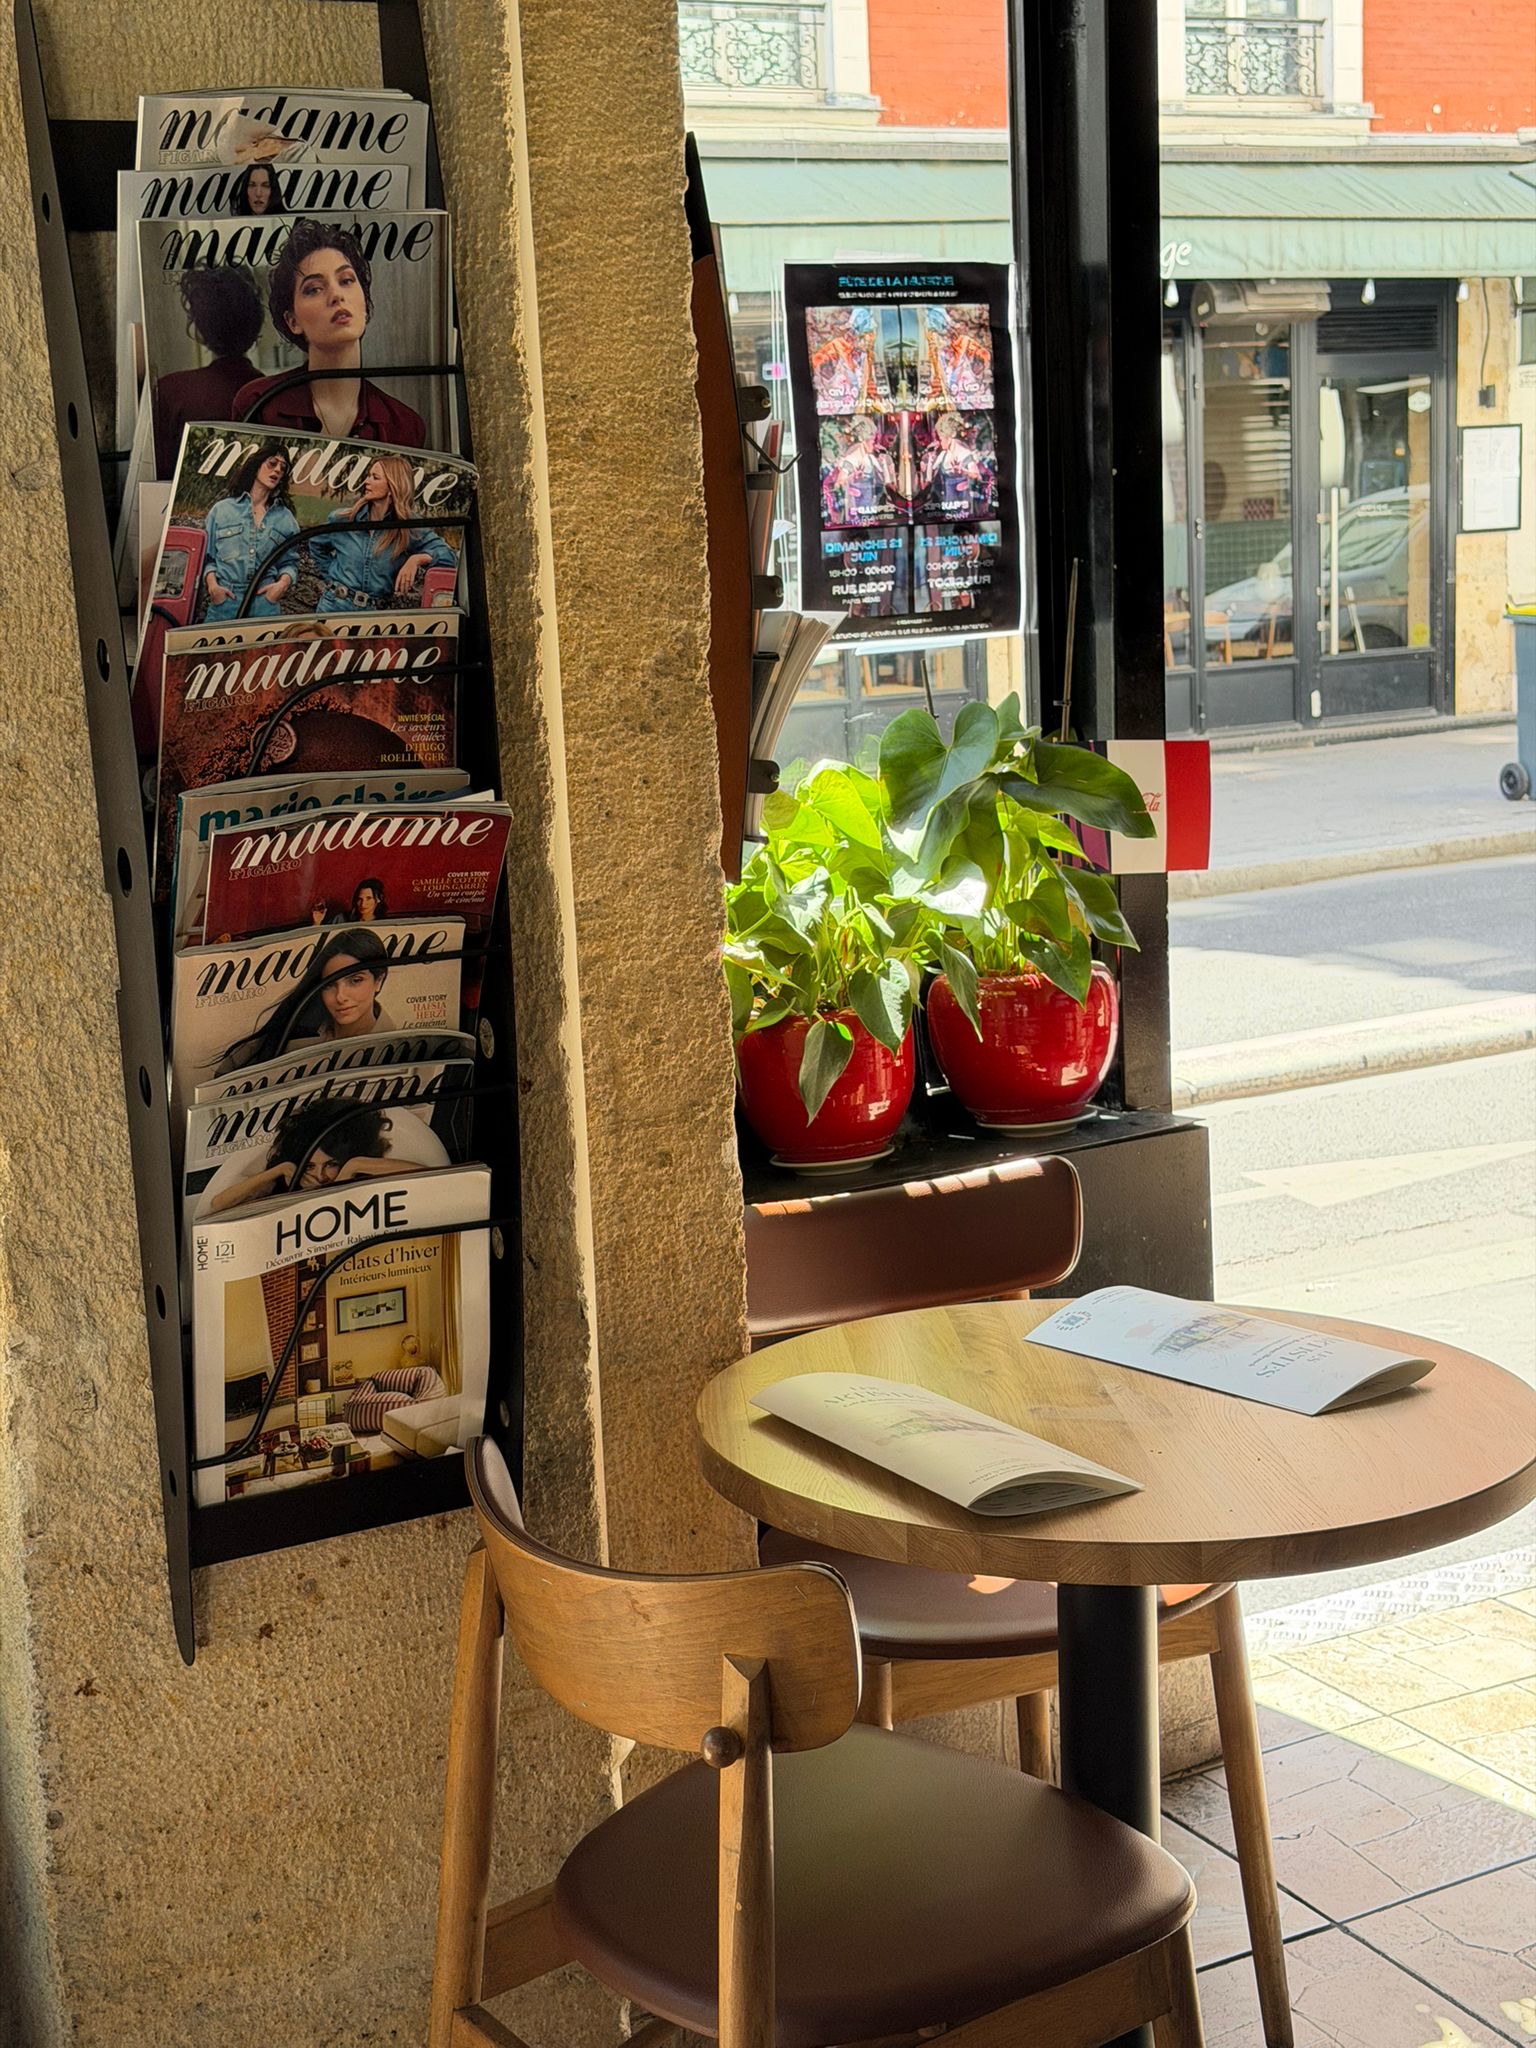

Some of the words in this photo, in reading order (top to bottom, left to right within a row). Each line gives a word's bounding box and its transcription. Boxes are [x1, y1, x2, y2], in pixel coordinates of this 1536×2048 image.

[184, 640, 441, 700] madame
[184, 691, 257, 713] FIGARO
[390, 722, 406, 732] Les
[408, 722, 446, 732] saveurs
[411, 732, 446, 742] étoilées
[380, 753, 445, 763] ROELLINGER
[406, 742, 446, 752] D'HUGO
[231, 811, 494, 870] madame
[229, 859, 301, 881] FIGARO
[412, 877, 451, 886] CAMILLE
[453, 876, 488, 884] COTTIN
[423, 884, 450, 892] LOUIS
[195, 985, 267, 1009] FIGARO
[406, 995, 427, 1004] COVER
[428, 994, 447, 1002] STORY
[416, 1010, 446, 1019] HERZI
[206, 1132, 274, 1158] FIGARO
[276, 1190, 408, 1255] HOME
[216, 1243, 235, 1257] 121
[265, 1251, 303, 1270] Découvrir
[306, 1239, 344, 1256] S'inspirer
[333, 1254, 380, 1274] clats
[384, 1245, 440, 1265] d'hiver
[340, 1272, 386, 1286] Intérieurs
[388, 1264, 432, 1277] lumineux
